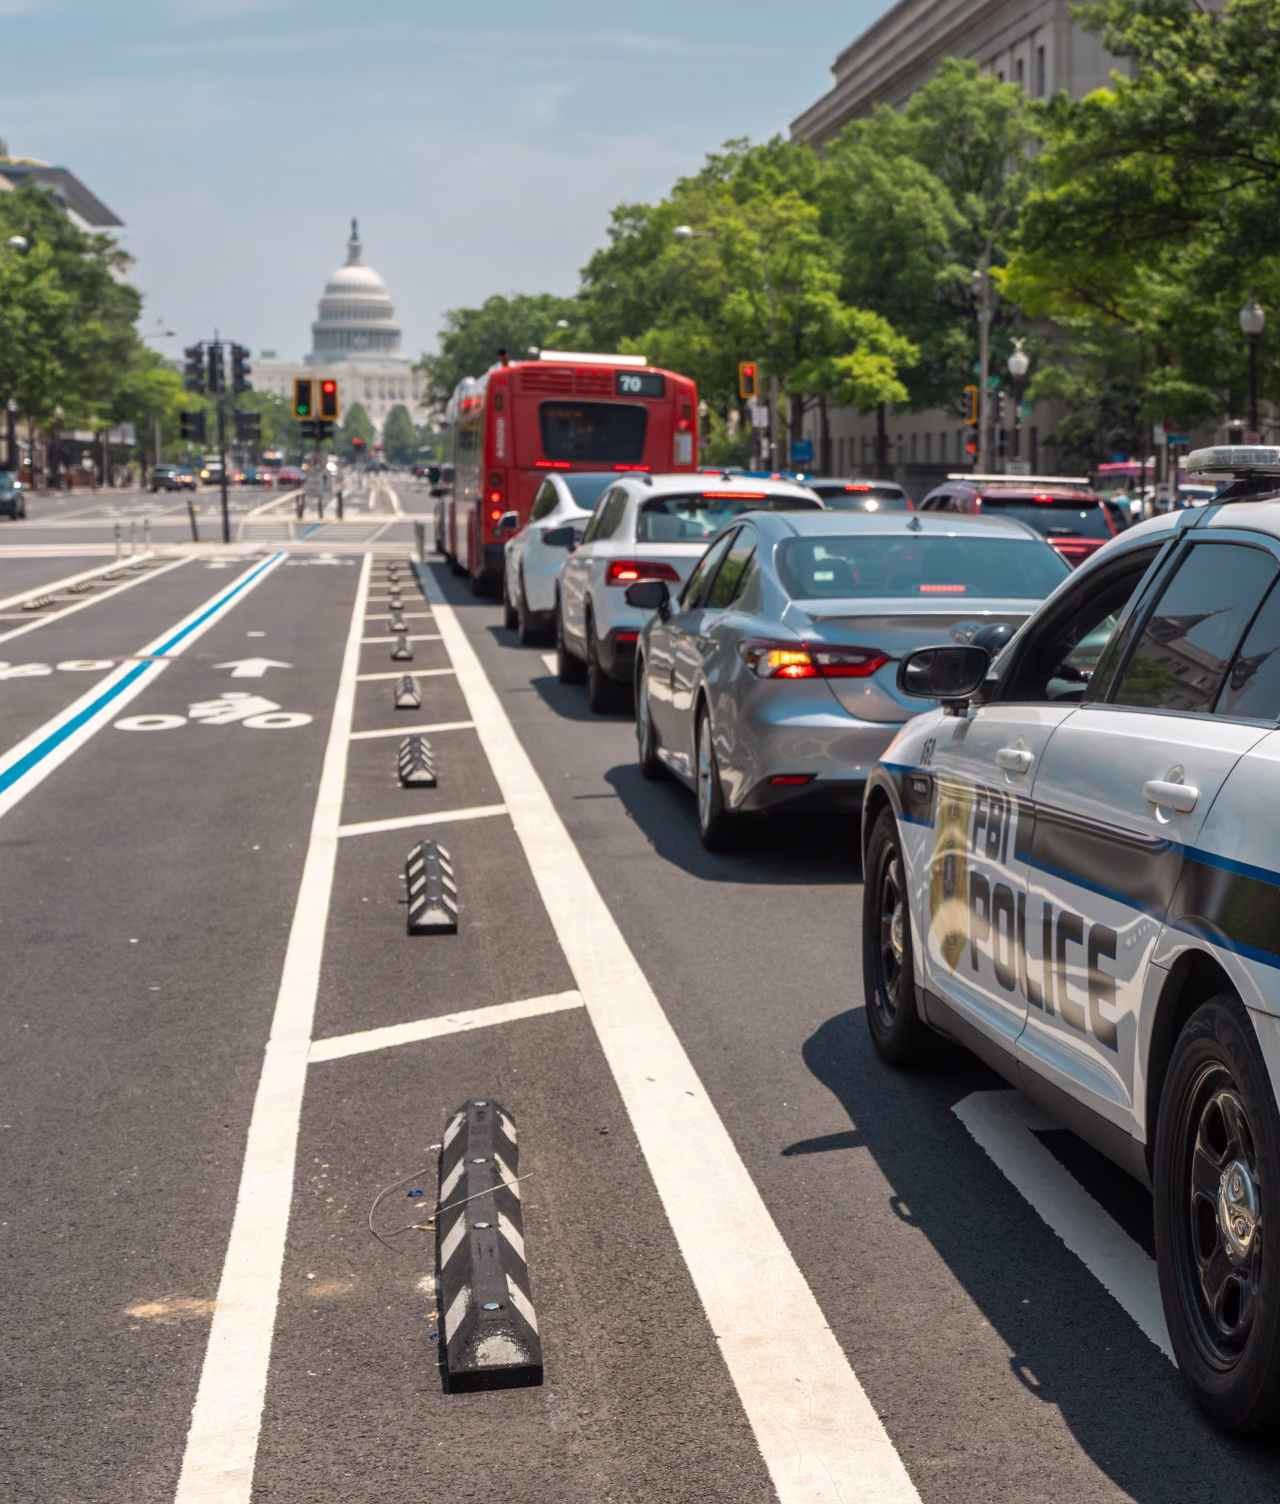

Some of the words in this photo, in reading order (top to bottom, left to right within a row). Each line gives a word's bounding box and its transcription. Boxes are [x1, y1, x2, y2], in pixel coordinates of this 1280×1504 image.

[620, 375, 641, 392] 70
[920, 738, 937, 766] 152
[973, 784, 1013, 865] FBI
[970, 871, 1119, 1054] POLICE
